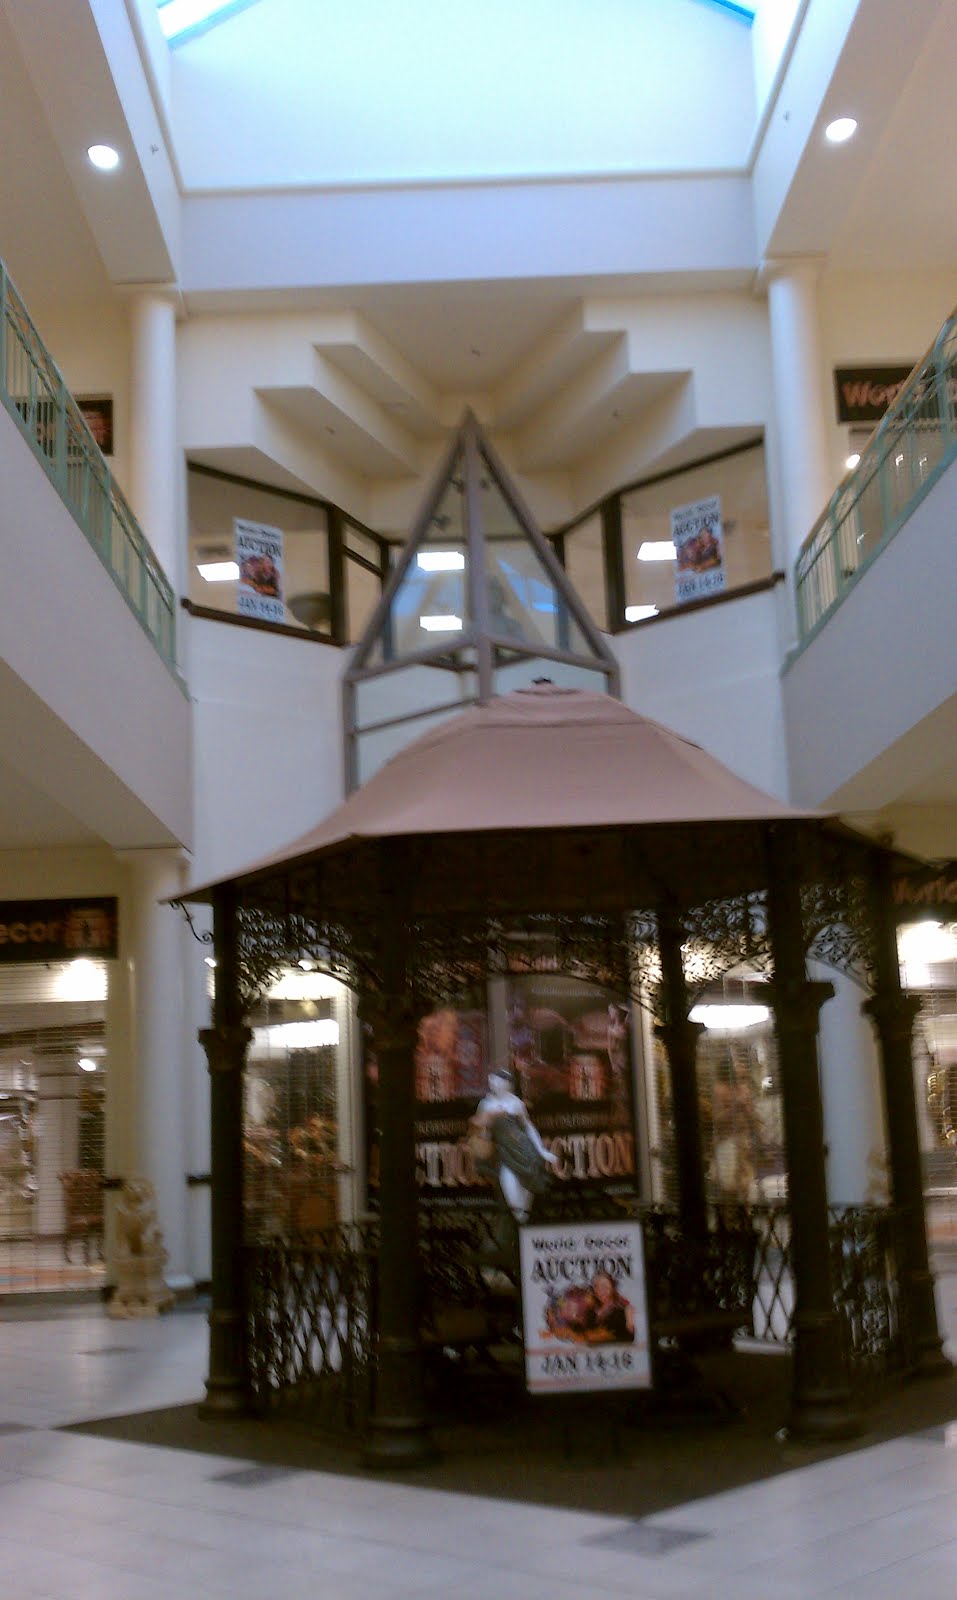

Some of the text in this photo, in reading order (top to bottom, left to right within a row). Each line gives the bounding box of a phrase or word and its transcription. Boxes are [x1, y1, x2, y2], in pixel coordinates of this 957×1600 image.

[545, 1132, 635, 1180] CTION
[530, 1253, 634, 1284] AUCTION
[541, 1352, 578, 1375] JAN
